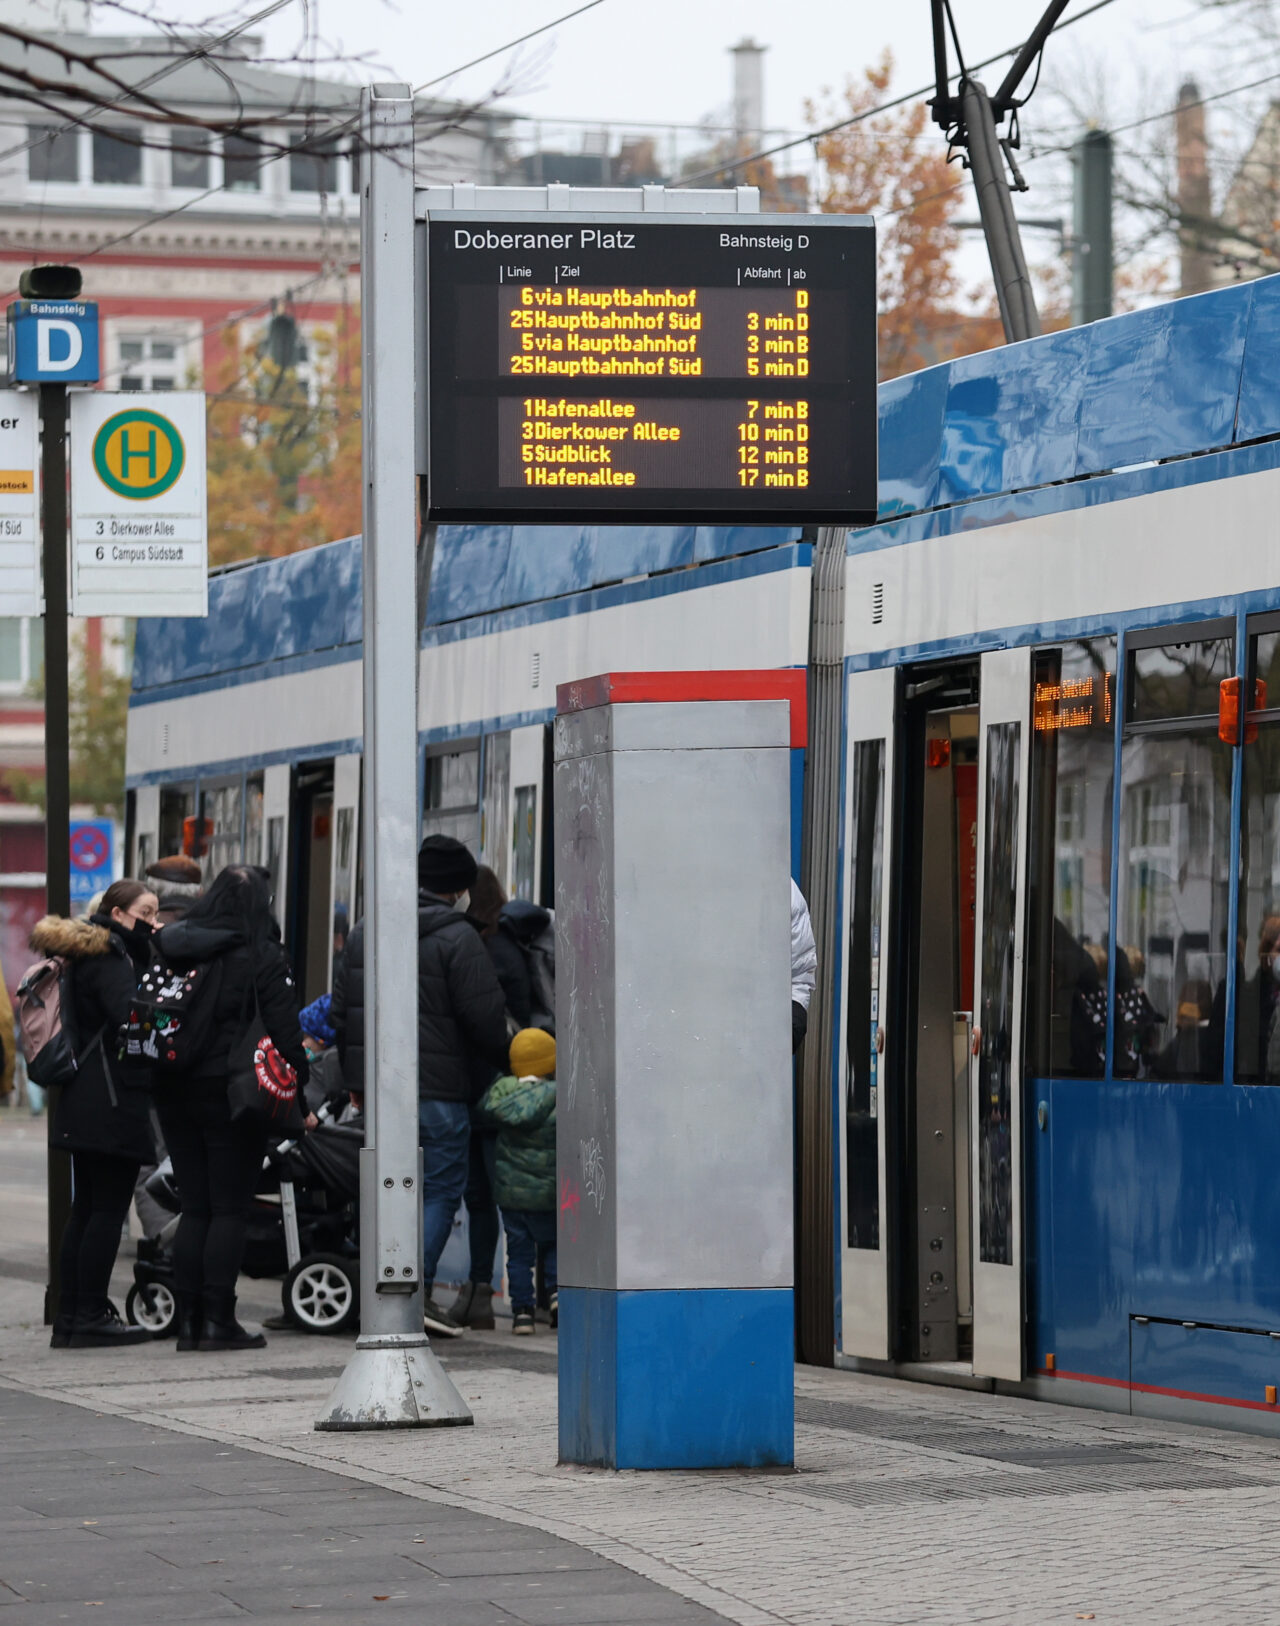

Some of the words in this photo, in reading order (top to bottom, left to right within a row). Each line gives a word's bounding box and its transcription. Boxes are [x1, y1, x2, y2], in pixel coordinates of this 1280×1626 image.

[454, 229, 574, 250] Doberaner
[580, 229, 637, 250] Platz
[719, 233, 794, 252] Bahnsteig
[798, 235, 810, 249] D
[507, 265, 532, 278] Linie
[560, 265, 581, 278] Ziel
[743, 267, 782, 279] Abfahrt
[792, 268, 807, 280] ab
[521, 287, 533, 306] 6
[535, 287, 563, 306] via
[566, 287, 697, 310] Hauptbahnhof
[796, 290, 809, 309] D
[30, 304, 86, 316] Bahnsteig
[510, 309, 533, 329] 25
[534, 310, 665, 332] Hauptbahnhof
[668, 311, 702, 330] Süd
[747, 312, 759, 331] 3
[764, 312, 794, 331] min
[796, 312, 809, 331] D
[37, 319, 83, 372] D
[521, 332, 533, 351] 5
[535, 333, 563, 352] via
[567, 333, 697, 356] Hauptbahnhof
[747, 334, 759, 354] 3
[764, 335, 794, 354] min
[796, 335, 809, 354] B
[510, 355, 533, 374] 25
[534, 355, 665, 378] Hauptbahnhof
[668, 357, 702, 376] Süd
[747, 357, 759, 376] 5
[764, 358, 794, 377] min
[796, 357, 809, 377] D
[523, 398, 533, 417] 1
[534, 398, 636, 418] Hafenallee
[747, 400, 759, 419] 7
[764, 400, 794, 419] min
[796, 400, 808, 420] B
[522, 421, 533, 440] 3
[534, 421, 629, 441] Dierkower
[633, 422, 681, 441] Allee
[737, 423, 759, 442] 10
[764, 423, 794, 442] min
[796, 423, 809, 442] D
[121, 430, 157, 479] H
[521, 444, 533, 463] 5
[534, 444, 611, 463] Südblick
[738, 445, 759, 464] 12
[764, 446, 794, 464] min
[796, 446, 809, 465] B
[523, 467, 533, 486] 1
[535, 467, 636, 486] Hafenallee
[738, 468, 759, 487] 17
[764, 468, 794, 487] min
[796, 468, 809, 487] B
[96, 521, 105, 535] 3
[111, 521, 153, 535] Dierkower
[154, 522, 175, 535] Allee
[95, 547, 105, 560] 6
[112, 547, 146, 563] Campus
[148, 546, 183, 561] Südstadt
